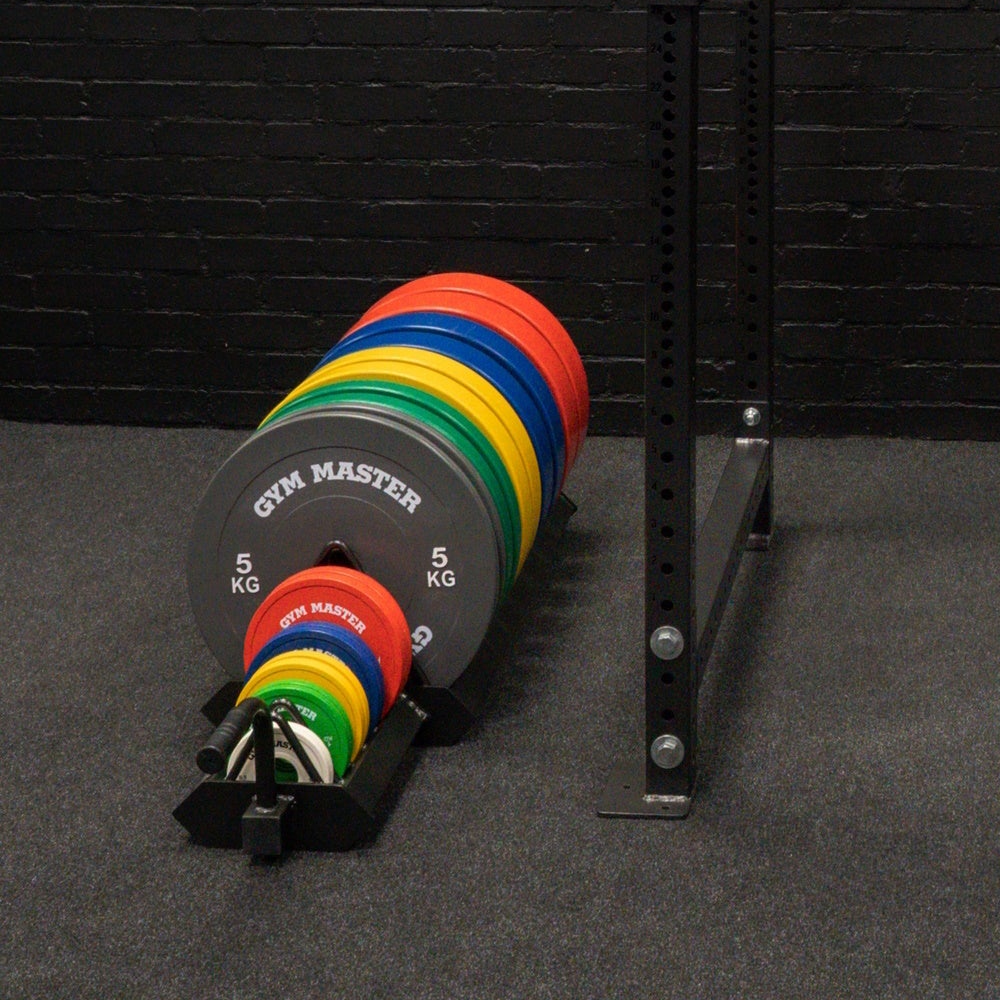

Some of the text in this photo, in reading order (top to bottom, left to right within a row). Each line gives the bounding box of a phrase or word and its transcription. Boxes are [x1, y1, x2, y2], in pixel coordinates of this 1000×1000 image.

[253, 461, 422, 518] GYM MASTER
[236, 553, 252, 575] 5
[431, 547, 449, 568] 5
[231, 576, 260, 594] KG
[427, 570, 456, 588] KG
[279, 602, 367, 635] GYM MASTER
